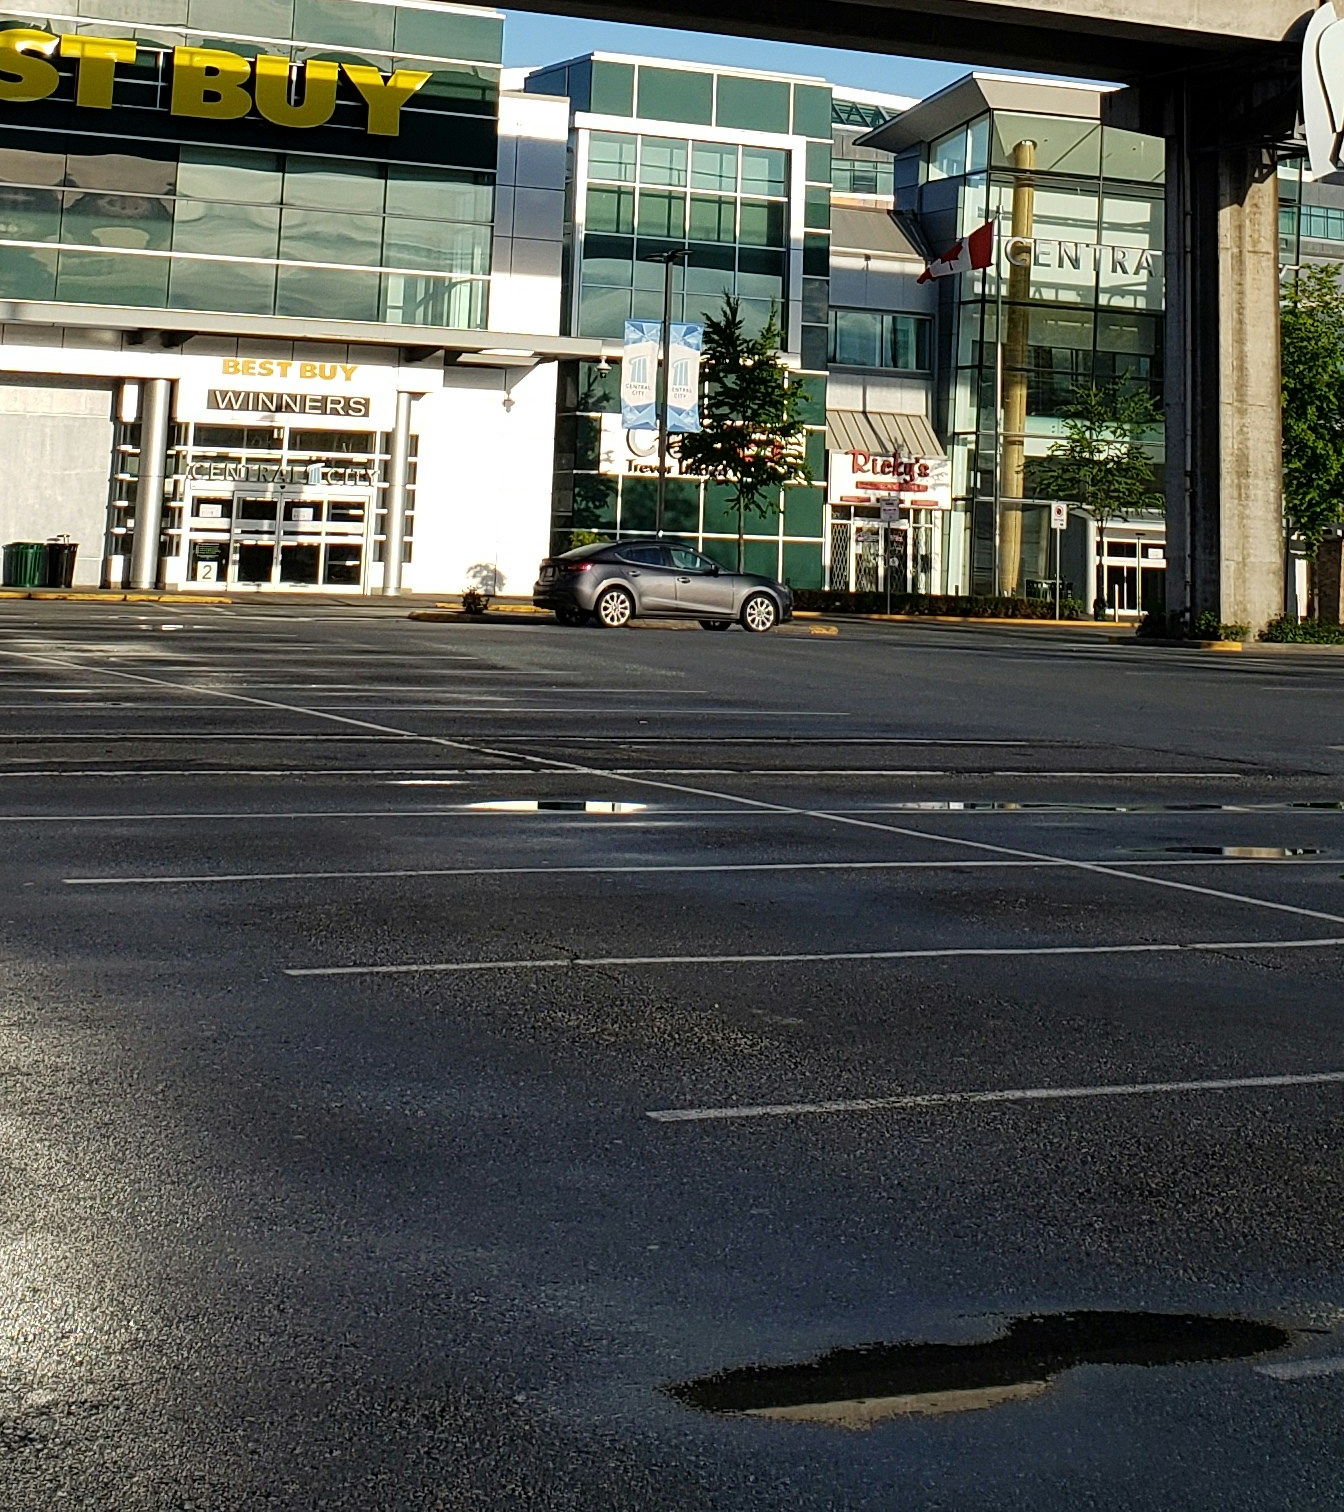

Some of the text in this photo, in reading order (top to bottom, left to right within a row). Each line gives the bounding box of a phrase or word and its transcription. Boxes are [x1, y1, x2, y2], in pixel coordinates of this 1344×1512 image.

[169, 45, 434, 137] BUY
[1005, 236, 1155, 277] CENTRA
[222, 359, 359, 381] BEST BUY
[215, 390, 365, 416] WINNERS
[187, 462, 380, 486] CENTRAL CITY
[626, 459, 673, 474] Trevr
[844, 450, 930, 483] Ricky's
[201, 564, 212, 580] 2
